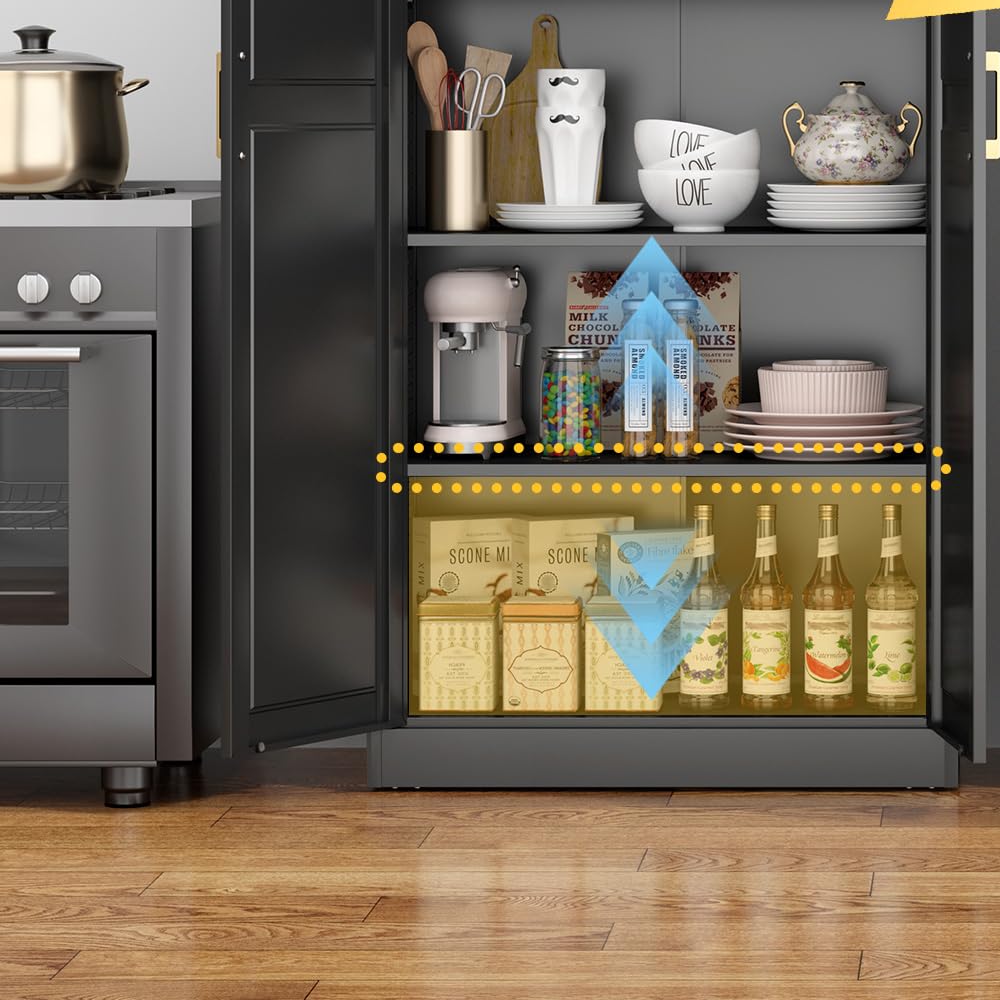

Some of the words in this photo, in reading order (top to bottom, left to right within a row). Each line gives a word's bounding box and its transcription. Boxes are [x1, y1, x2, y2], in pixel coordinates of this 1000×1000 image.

[675, 177, 712, 206] LOVE
[568, 312, 608, 321] MILK
[680, 347, 688, 380] SMOKED
[449, 547, 491, 564] SCONE
[548, 547, 589, 564] SCONE
[695, 652, 714, 662] Violet
[811, 650, 848, 659] Watermelon
